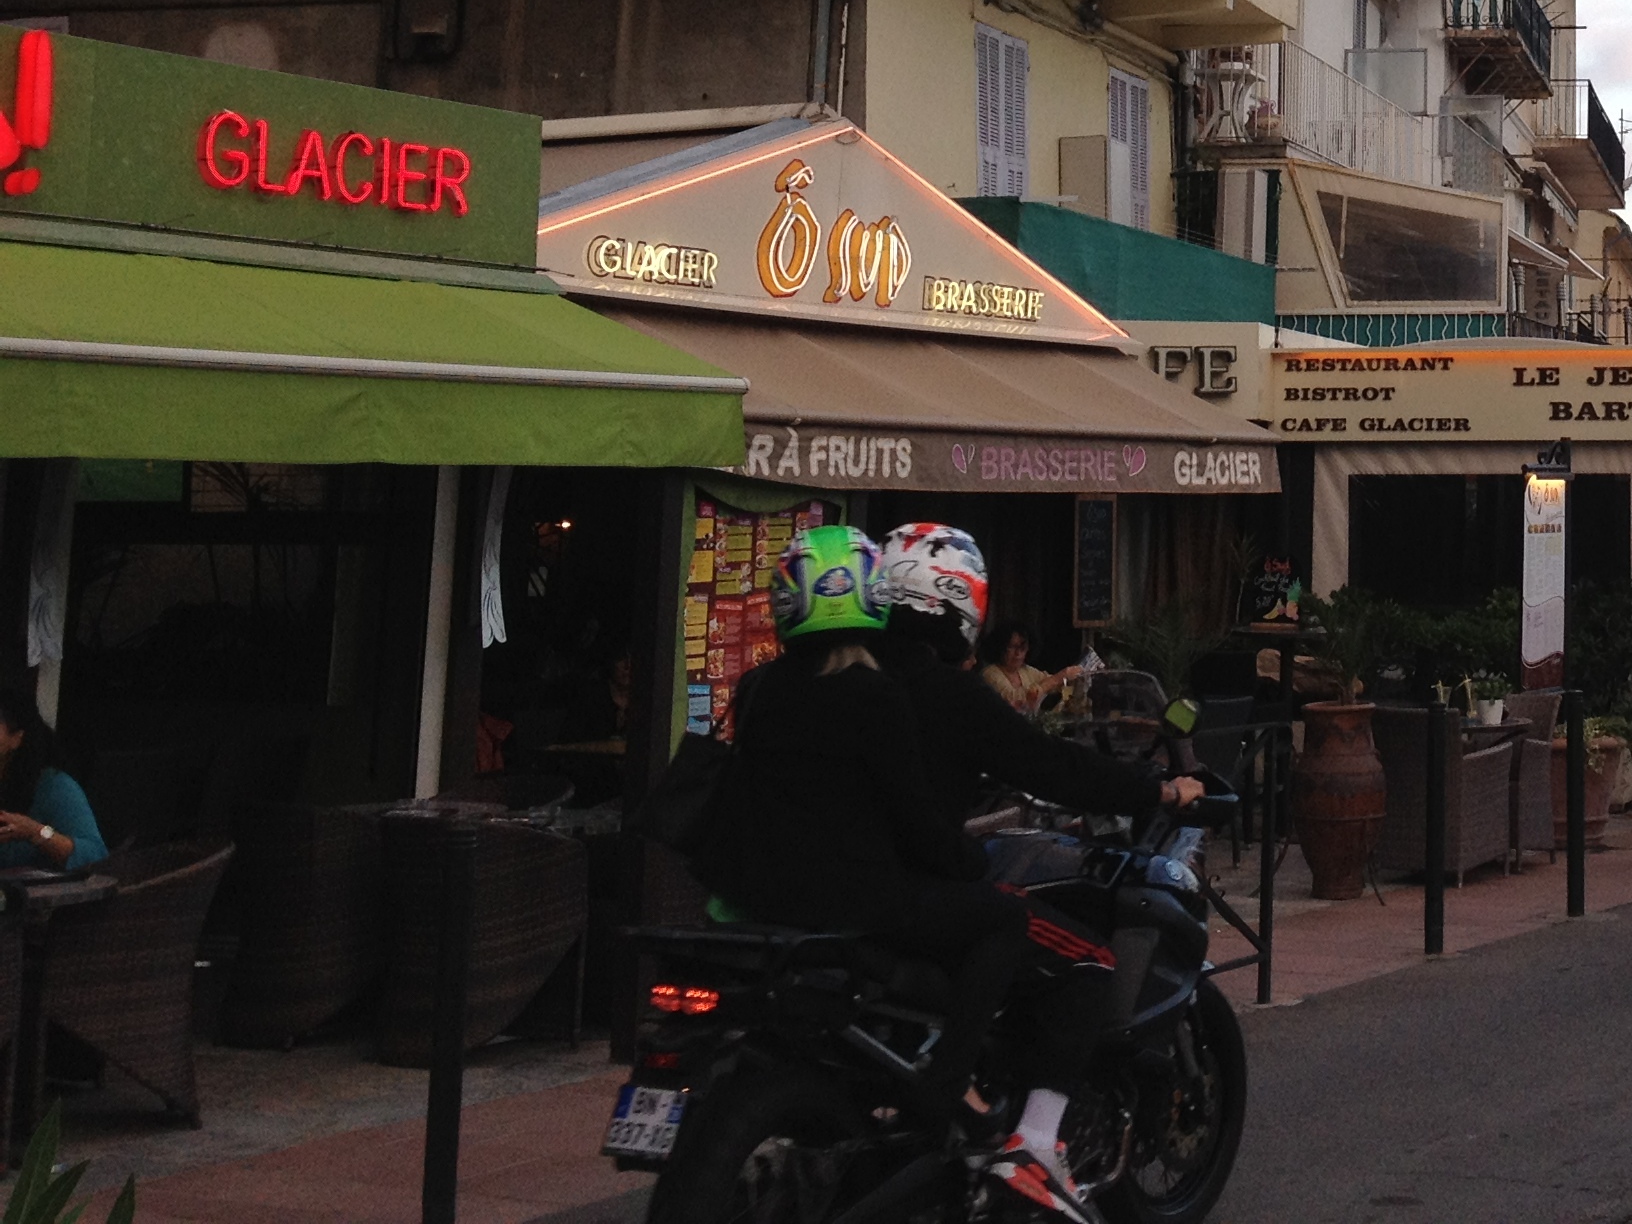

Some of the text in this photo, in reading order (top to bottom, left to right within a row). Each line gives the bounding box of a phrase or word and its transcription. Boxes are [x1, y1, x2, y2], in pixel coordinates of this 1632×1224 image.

[197, 109, 471, 217] GLACIER
[585, 233, 719, 289] GLACIER
[922, 275, 1045, 321] BRASSERIE
[1284, 357, 1454, 373] RESTAURANT
[1512, 367, 1560, 387] LE
[1283, 387, 1396, 402] BISTROT
[1280, 417, 1472, 432] CAFE GLACIER
[776, 426, 800, 477] À
[808, 437, 912, 478] FRUITS
[980, 446, 1118, 483] BRASSERIE
[1173, 450, 1262, 488] GLACIER
